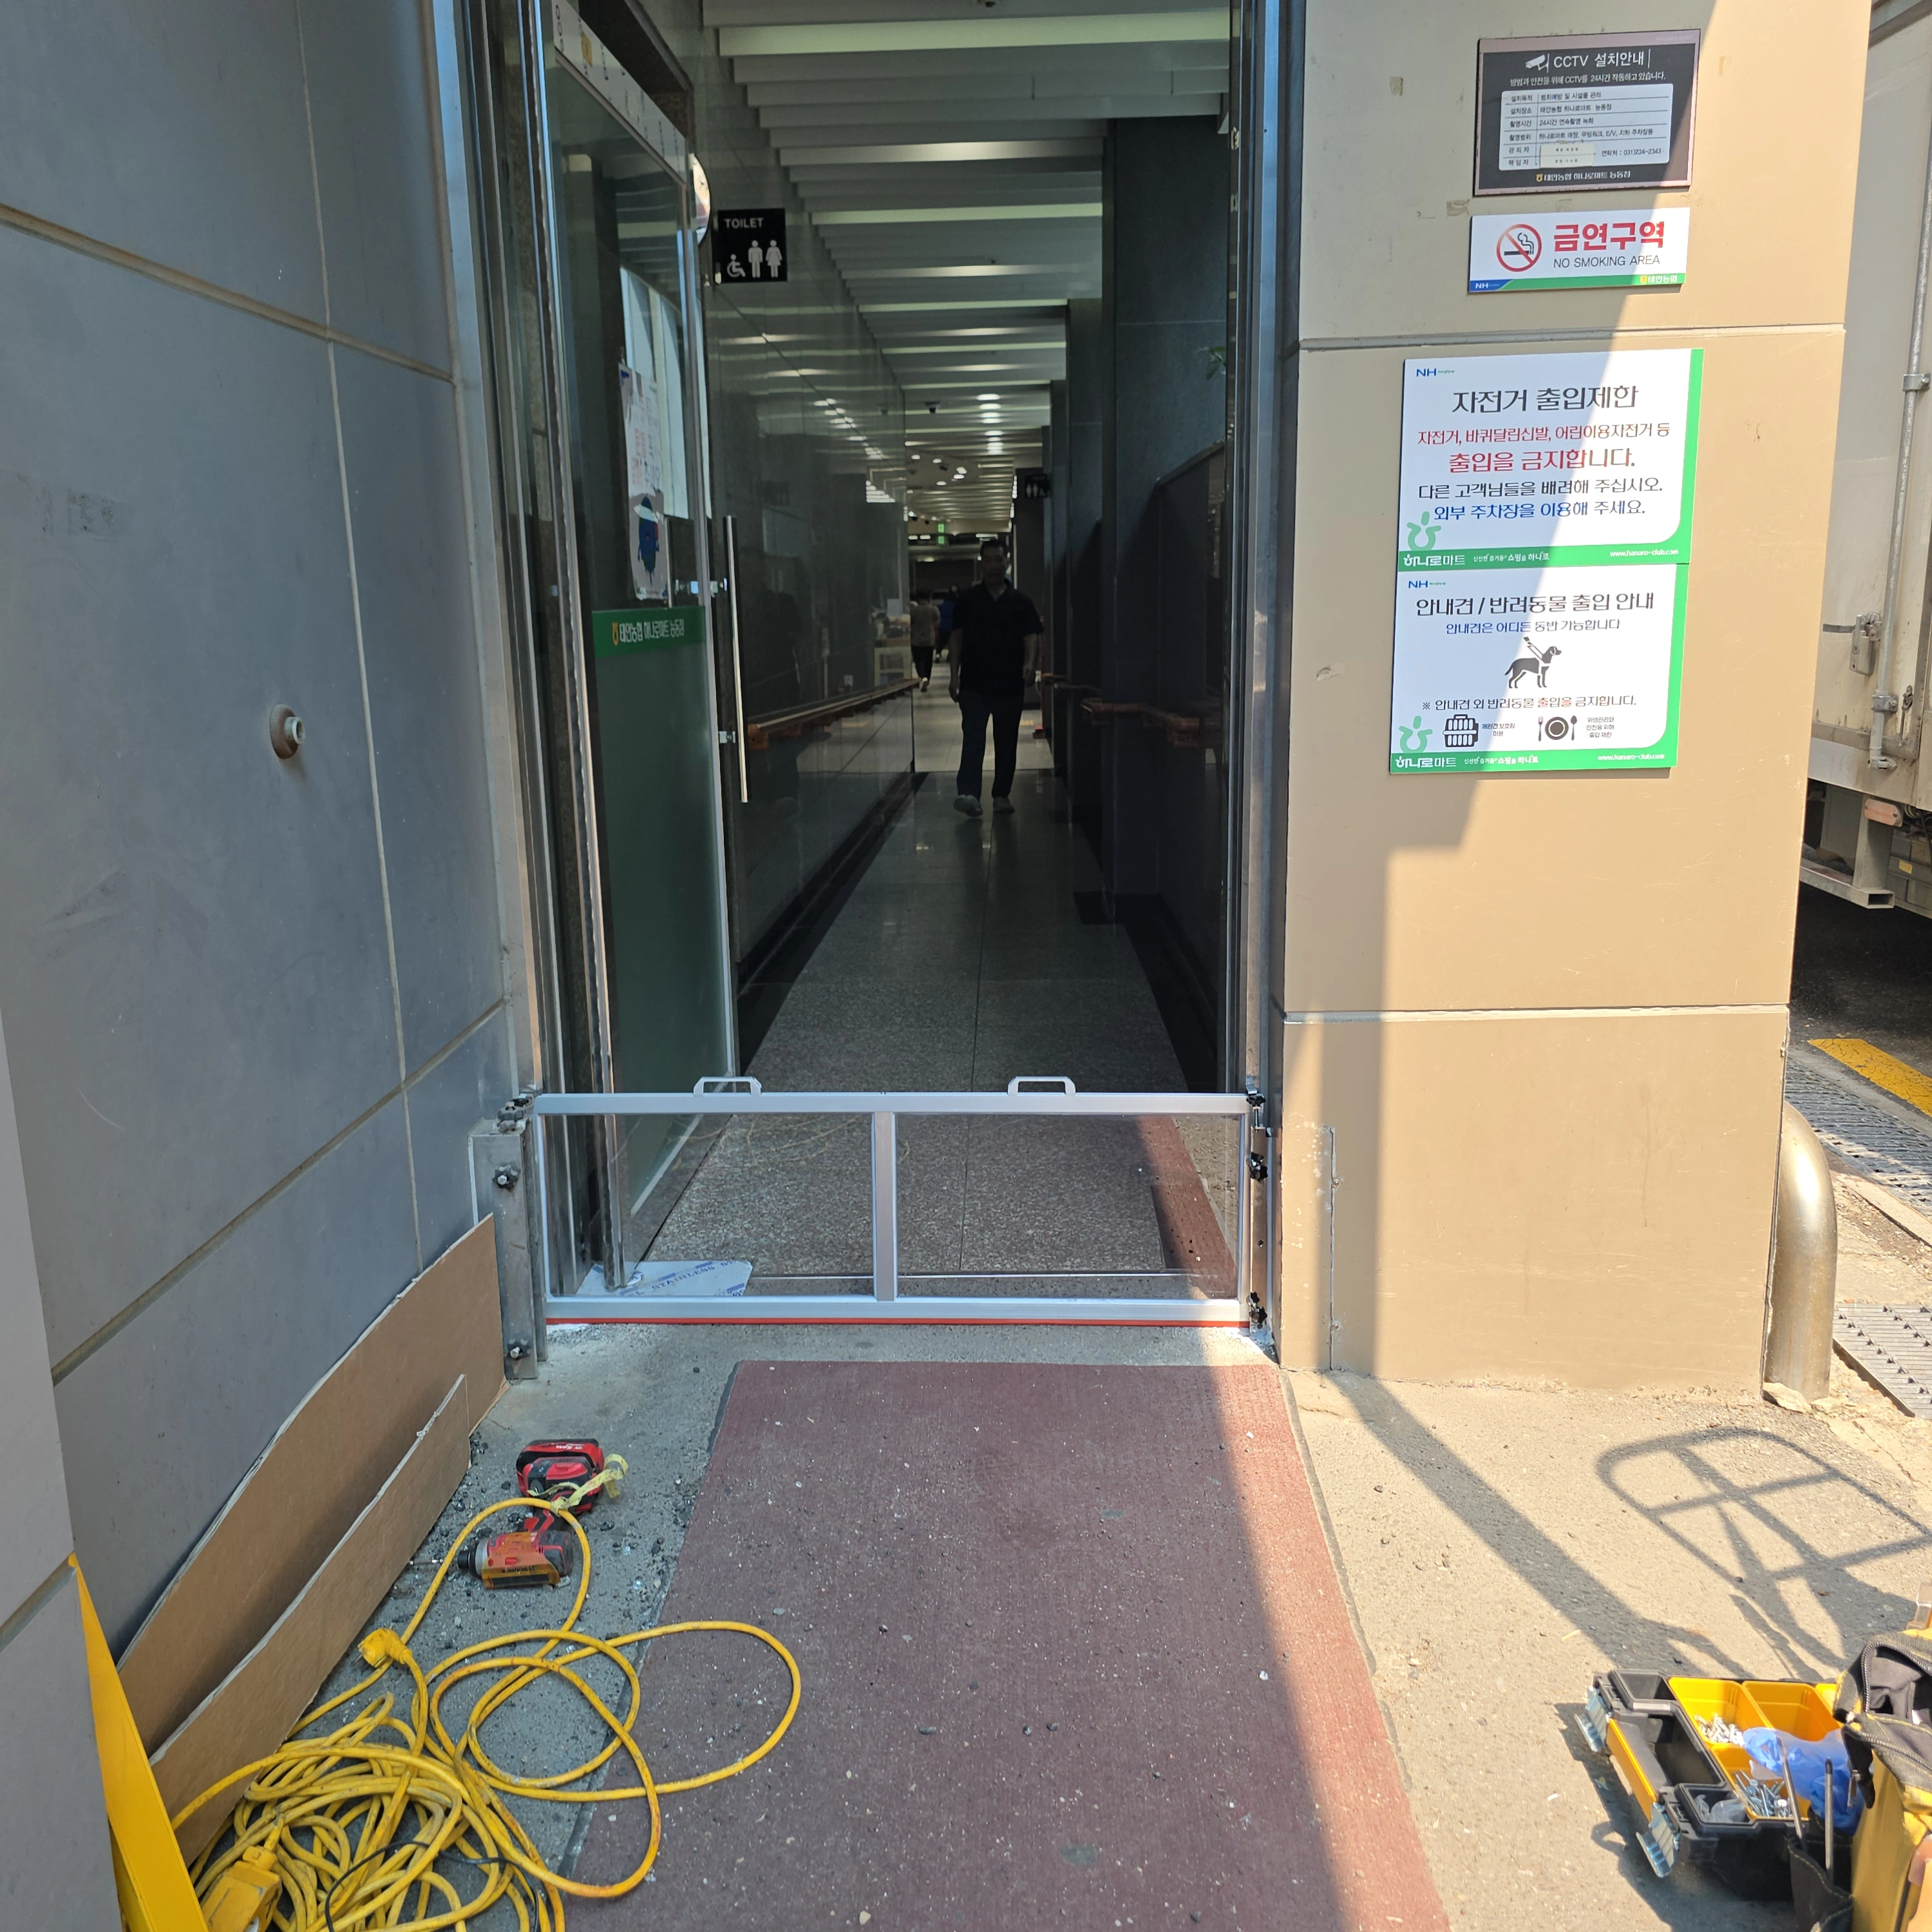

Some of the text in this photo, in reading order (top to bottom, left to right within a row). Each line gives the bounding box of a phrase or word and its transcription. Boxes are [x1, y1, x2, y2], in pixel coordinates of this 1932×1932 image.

[1553, 52, 1645, 68] CCTV 설치안내
[1509, 70, 1667, 87] 방범과 안전을 위해 CCTV를 24시간 작동하고 있습니다.
[1510, 94, 1533, 103] 설치목적
[1540, 92, 1563, 101] 범죄예방
[1572, 92, 1588, 100] 시설물
[1510, 107, 1532, 116] 설치장소
[1540, 105, 1562, 114] 태안농협
[1564, 104, 1591, 112] 하나로마트
[1510, 119, 1532, 128] 촬영시간
[1559, 118, 1581, 126] 연속촬영
[1509, 133, 1531, 142] 촬영범위
[1539, 132, 1565, 140] 하나로마트
[724, 218, 764, 229] TOILET
[1553, 221, 1665, 252] 금연구역
[1553, 255, 1660, 269] NO SMOKING AREA
[1416, 368, 1437, 377] NH
[1452, 385, 1639, 413] 자전거 출입제한
[1417, 423, 1670, 446] 자전거, 바퀴달린신발, 어린이용자전거 등
[1449, 448, 1635, 473] 출입을 금지합니다.
[1419, 477, 1663, 499] 다른 고객님들을 배려해 주십시오.
[1434, 500, 1645, 520] 외부 주차장을 이용해 주세요.
[1403, 553, 1466, 567] 하나로마트
[1507, 553, 1527, 562] 쇼핑을
[1528, 551, 1549, 561] 하나로
[1408, 580, 1428, 589] NH
[1416, 592, 1654, 616] 안내견 / 반려동물 출입 안내
[1446, 619, 1621, 635] 안내견은 어디든 동반 가능합니다
[1435, 699, 1470, 711] 안내견
[1473, 699, 1485, 710] 외
[1488, 698, 1534, 709] 반려동물
[1537, 697, 1572, 708] 출입을
[1575, 695, 1636, 707] 금지합니다.
[1395, 755, 1457, 769] 하나로마트
